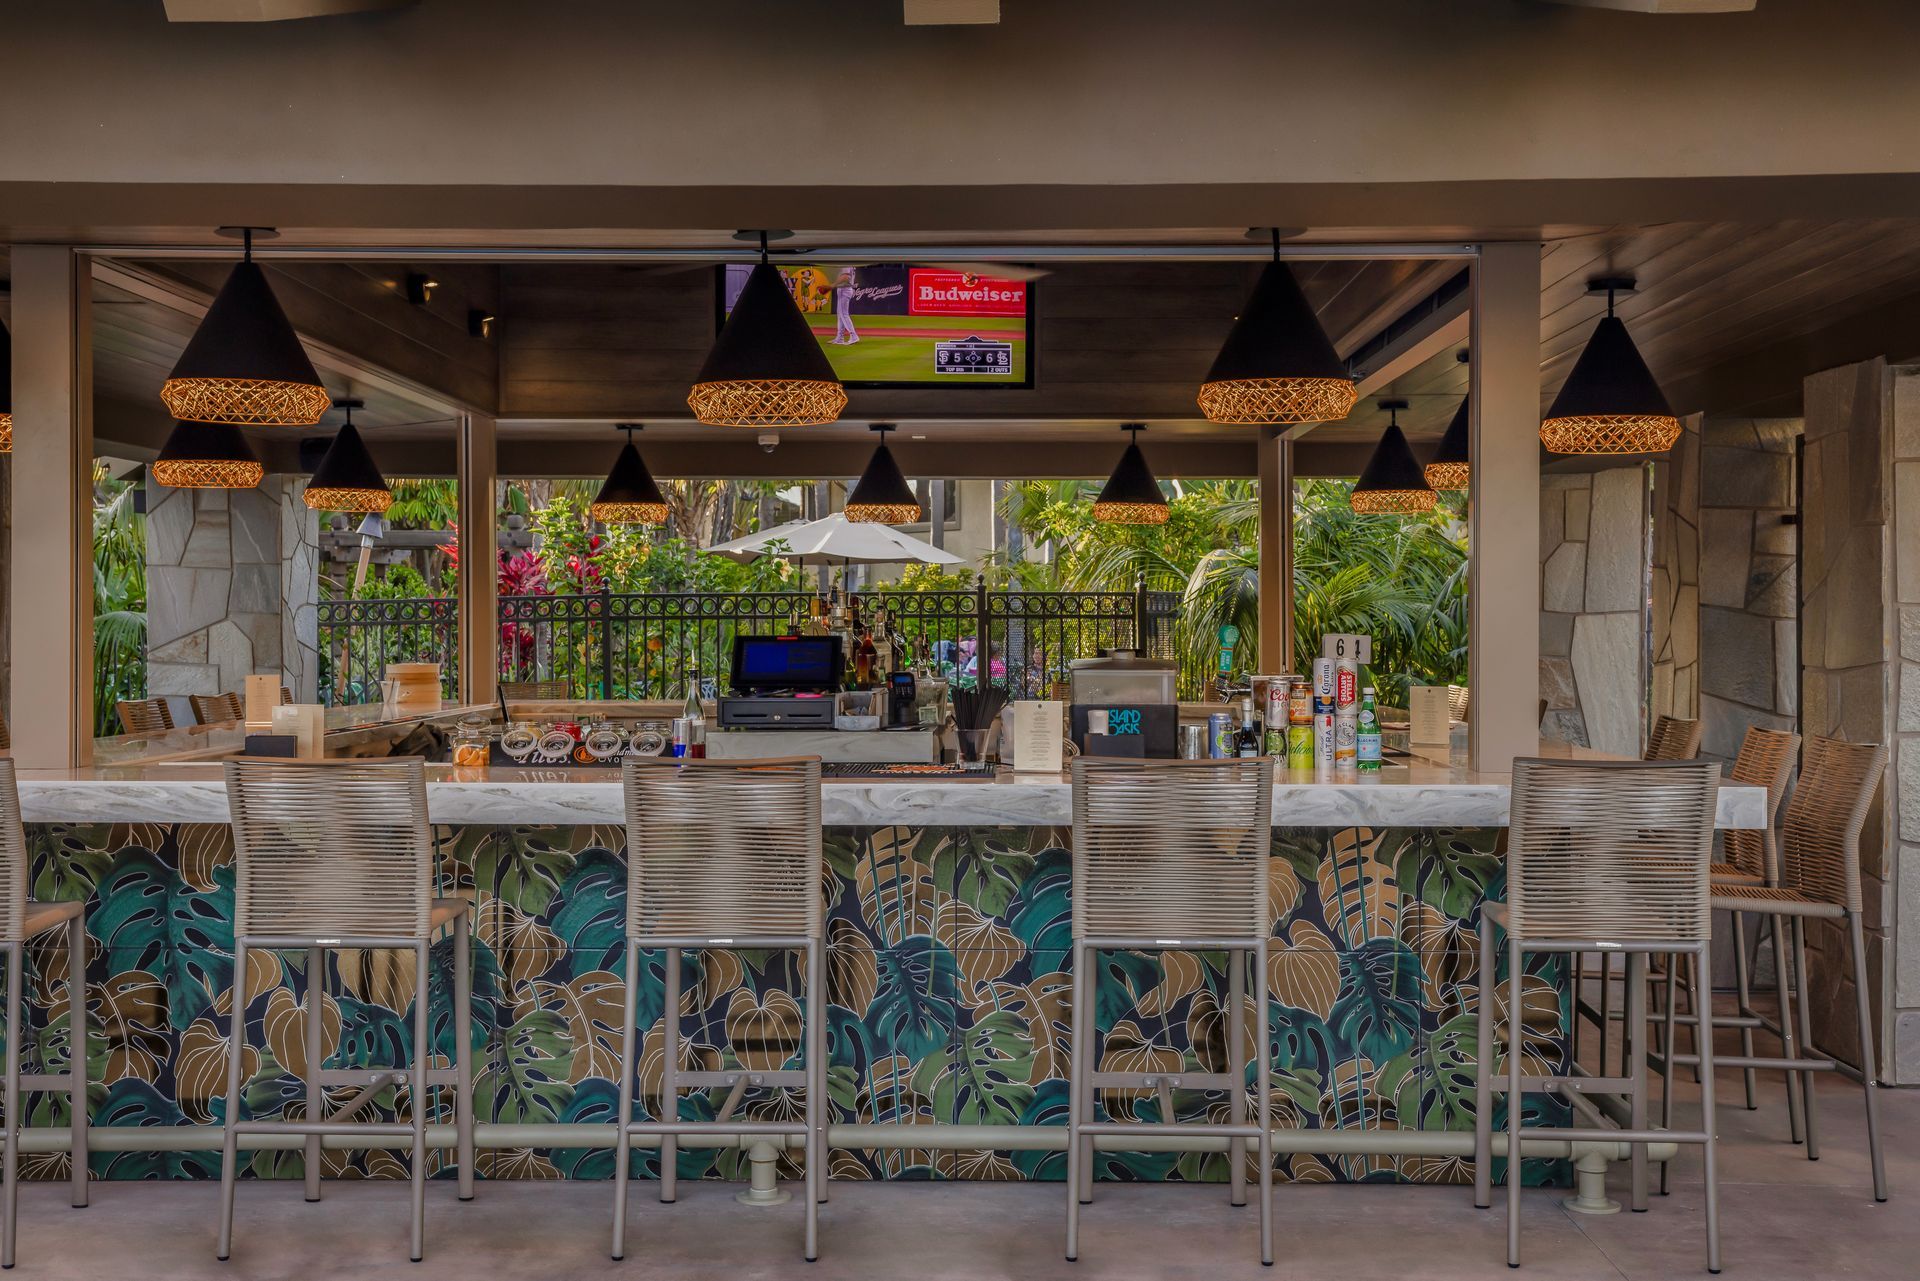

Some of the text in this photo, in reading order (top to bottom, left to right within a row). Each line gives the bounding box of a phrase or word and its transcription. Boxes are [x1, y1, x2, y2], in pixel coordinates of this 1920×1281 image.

[919, 286, 1024, 302] Budweiser
[954, 353, 961, 363] 5
[986, 353, 993, 363] 6
[1336, 638, 1345, 657] 6
[1321, 664, 1331, 695] Corona
